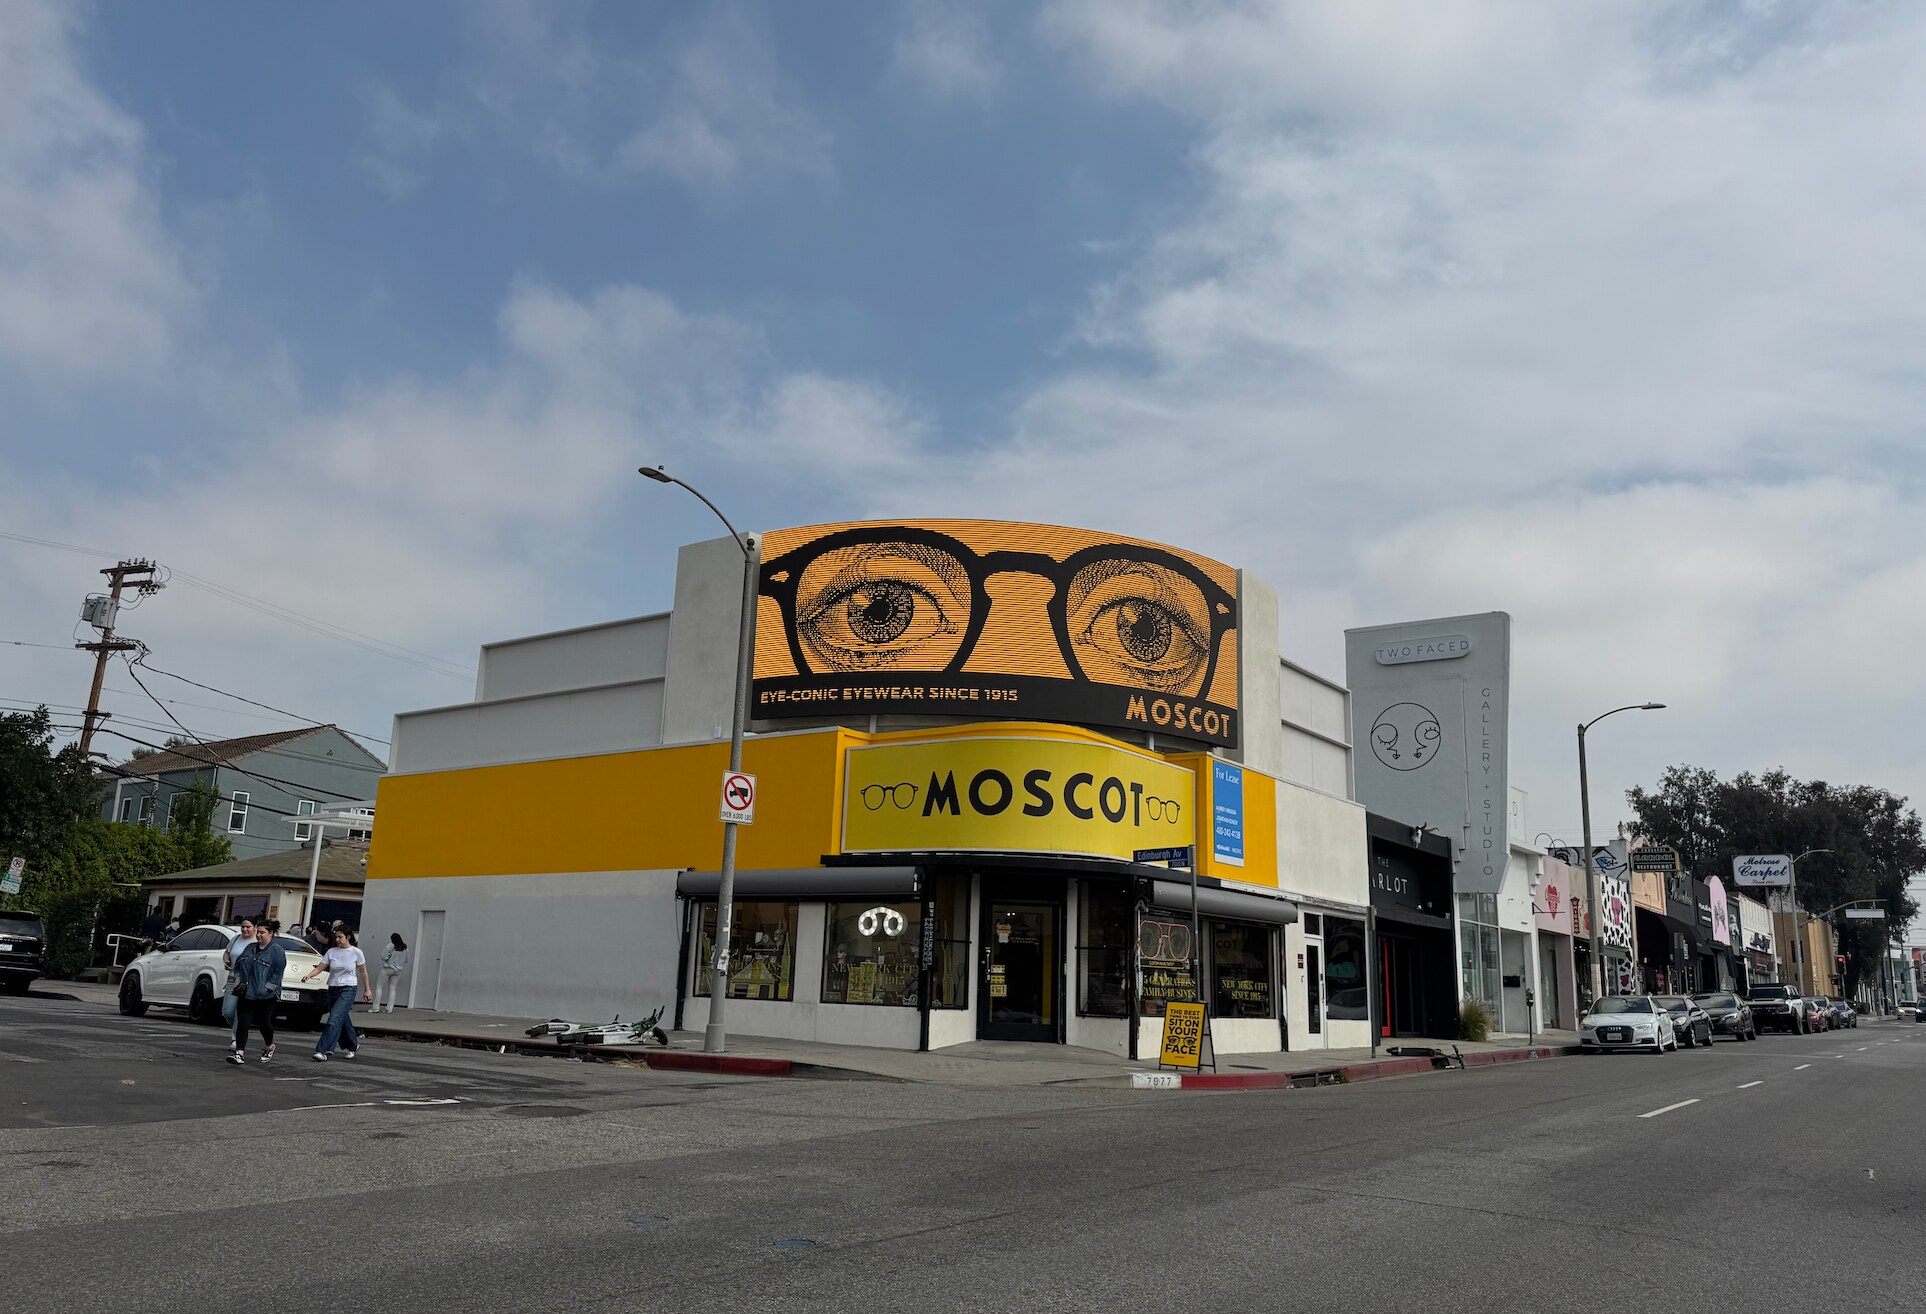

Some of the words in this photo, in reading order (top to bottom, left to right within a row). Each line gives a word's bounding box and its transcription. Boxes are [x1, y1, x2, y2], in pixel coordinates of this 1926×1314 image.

[1378, 647, 1411, 658] TWO
[1416, 641, 1469, 654] FACED
[760, 689, 838, 704] EYE-CONIC
[843, 687, 924, 700] EYEWEAR
[929, 687, 980, 701] SINCE
[985, 689, 1018, 702] 1915
[1125, 694, 1230, 738] MOSCOT
[1481, 688, 1491, 775] GALLERY
[1215, 767, 1225, 780] For
[1225, 770, 1239, 784] Lease
[921, 769, 1144, 827] MOSCOT
[1482, 800, 1493, 876] STUDIO
[1137, 850, 1171, 860] Edinburgh
[1173, 849, 1182, 858] Av
[1743, 856, 1780, 865] Melrose
[1377, 856, 1389, 867] THE
[1738, 865, 1788, 880] Carpet
[1144, 975, 1148, 984] 5
[1221, 979, 1236, 989] NEW
[1238, 980, 1254, 990] YORK
[1254, 982, 1268, 991] CITY
[1231, 990, 1250, 1000] SINCE
[1169, 1018, 1184, 1026] SIT
[1184, 1019, 1200, 1027] ON
[1168, 1026, 1198, 1036] YOUR
[1165, 1044, 1198, 1056] FACE.
[1146, 1077, 1172, 1086] 7977
